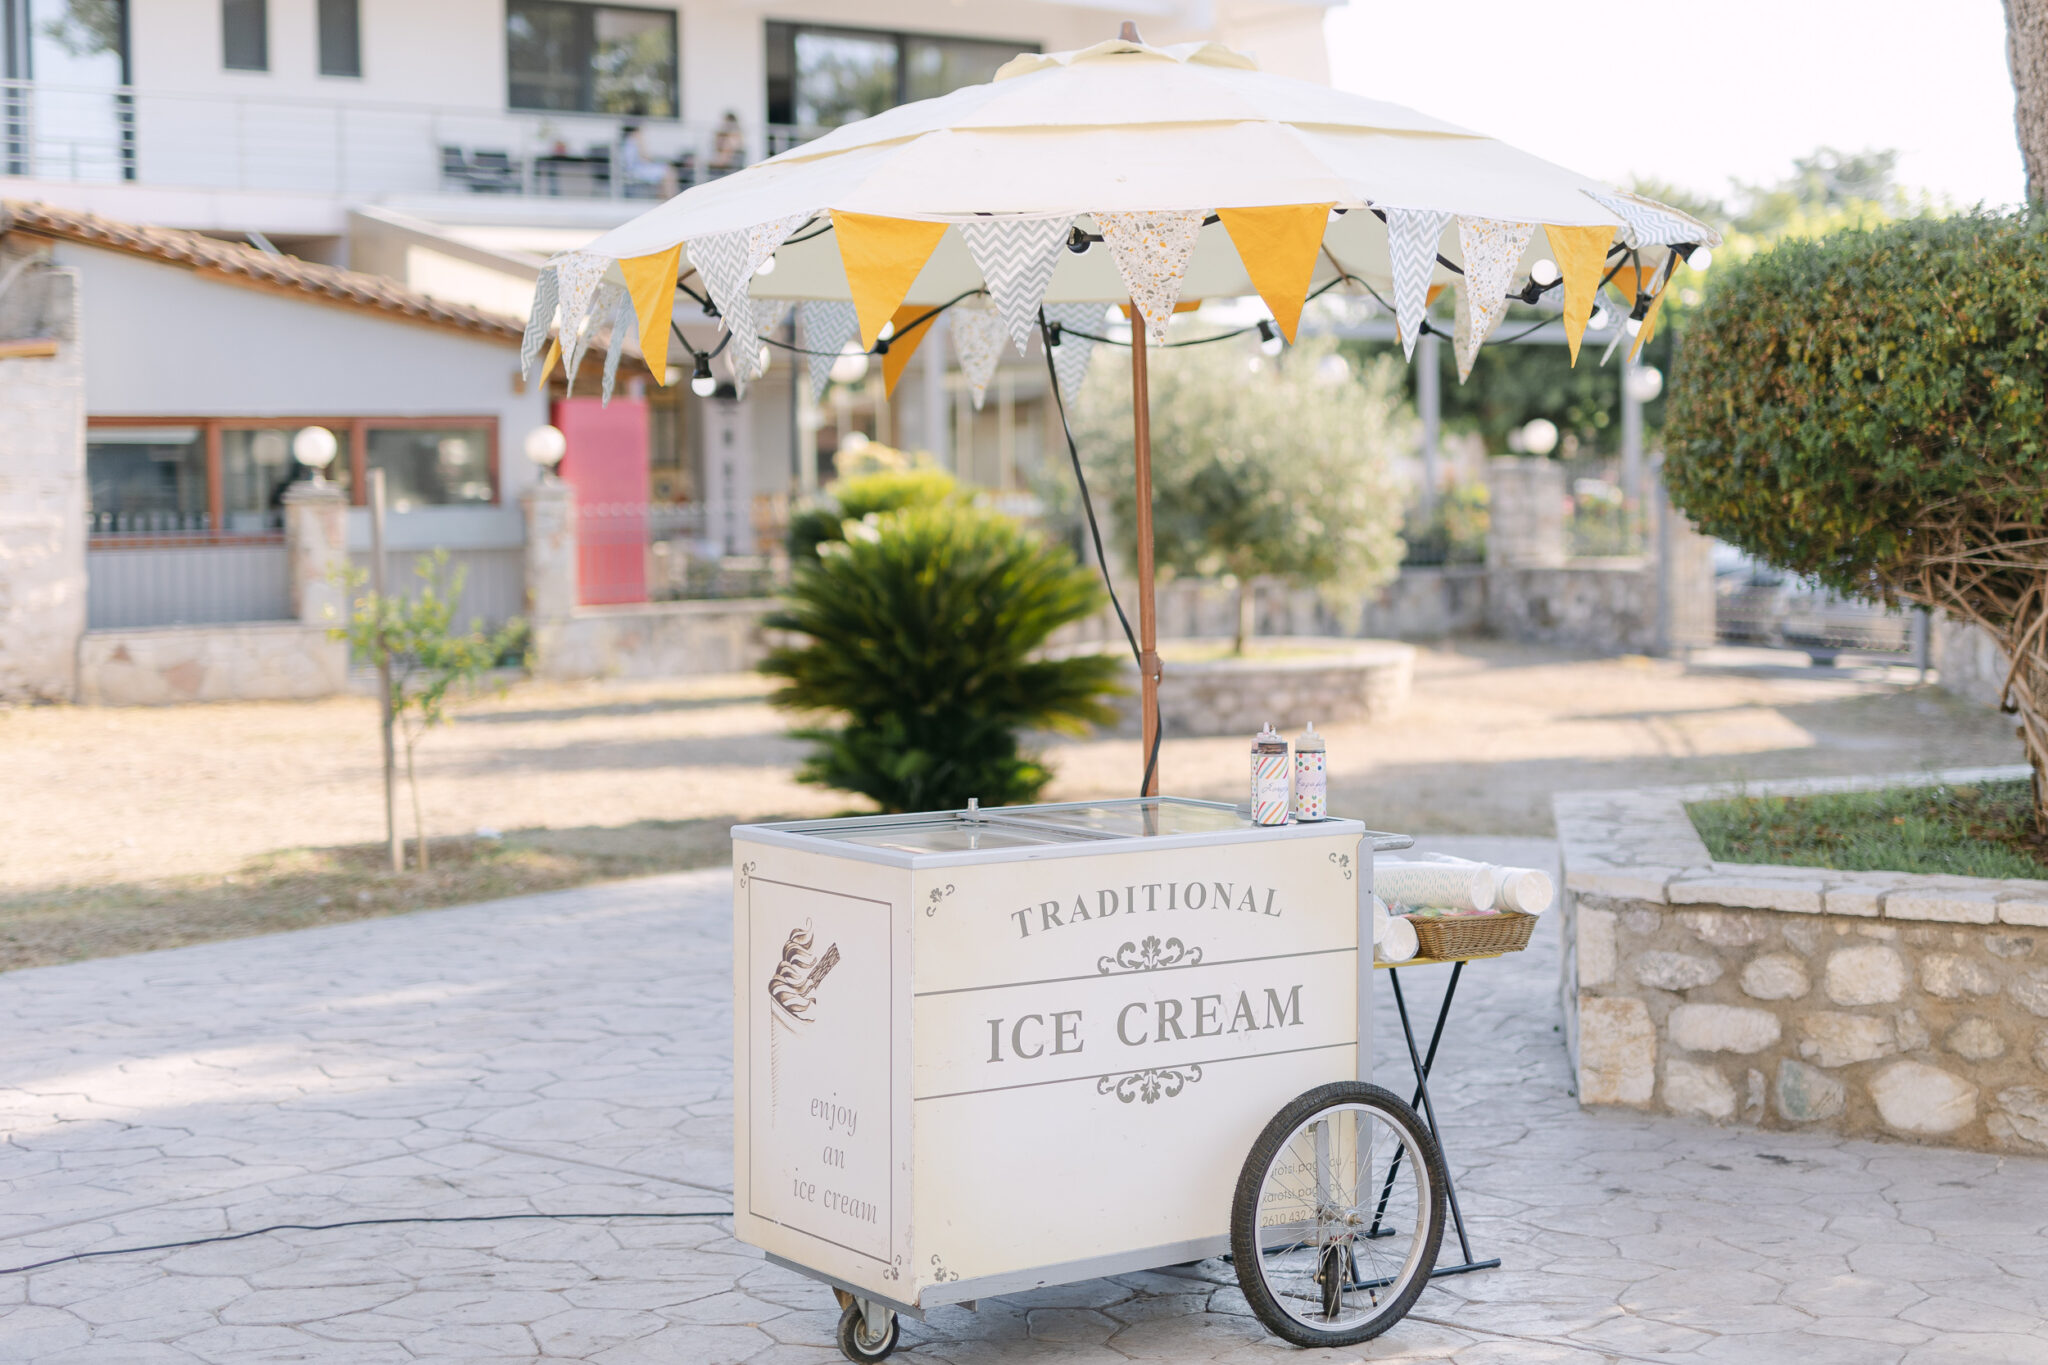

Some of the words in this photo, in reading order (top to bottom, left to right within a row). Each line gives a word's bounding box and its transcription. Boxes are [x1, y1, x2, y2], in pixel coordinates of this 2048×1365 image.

[1011, 882, 1282, 939] TRADITIONAL
[987, 1010, 1084, 1063] ICE
[1116, 985, 1304, 1046] CREAM
[811, 1092, 858, 1136] enjoy
[823, 1146, 845, 1169] an
[793, 1167, 816, 1202] ice
[824, 1189, 877, 1224] cream
[1262, 1213, 1287, 1227] 2610
